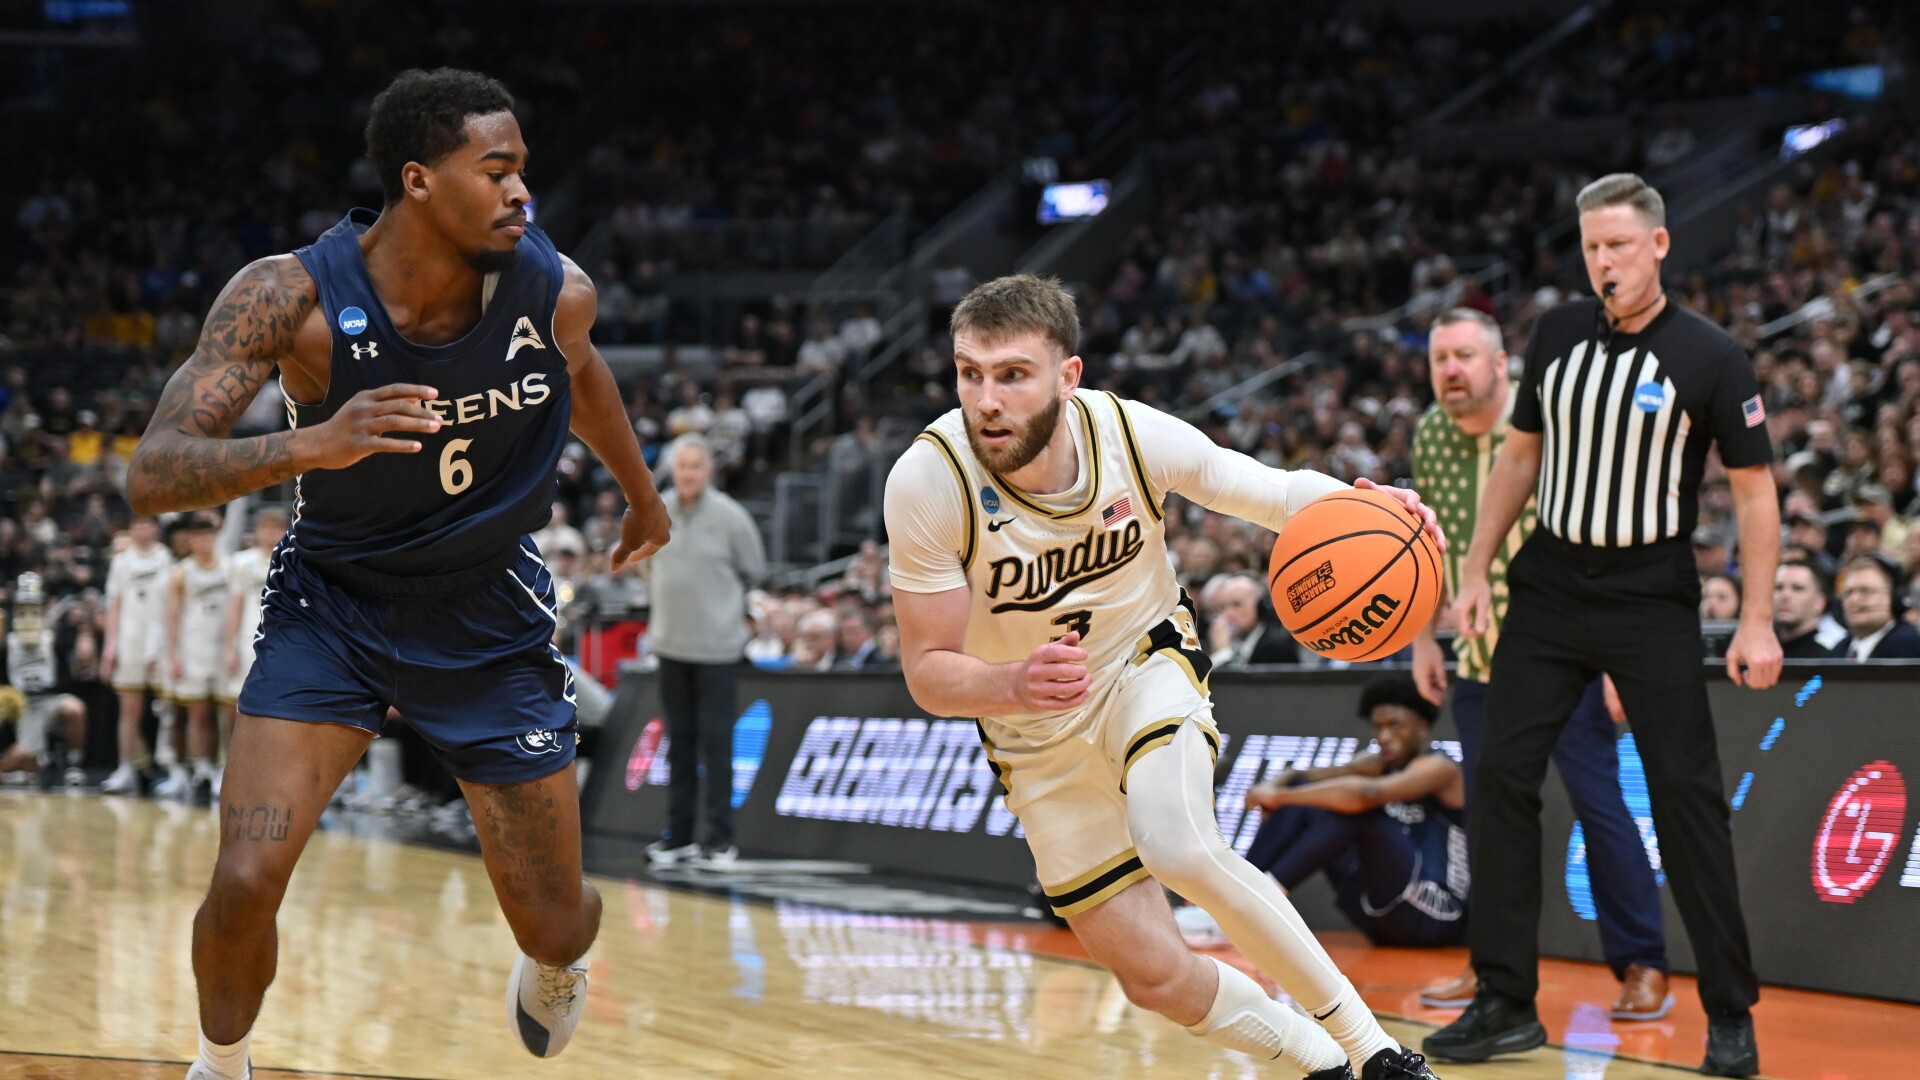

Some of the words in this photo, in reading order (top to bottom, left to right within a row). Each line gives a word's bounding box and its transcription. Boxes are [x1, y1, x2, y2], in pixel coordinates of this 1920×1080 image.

[343, 318, 366, 329] NCAA
[439, 438, 474, 496] 6
[984, 498, 1000, 507] NCAA
[985, 519, 1143, 606] Purdue
[1287, 574, 1319, 602] MADNESS
[1299, 580, 1328, 603] MARCH
[1304, 593, 1401, 653] Wilson
[1321, 625, 1335, 636] NXT
[1335, 615, 1349, 628] EVO
